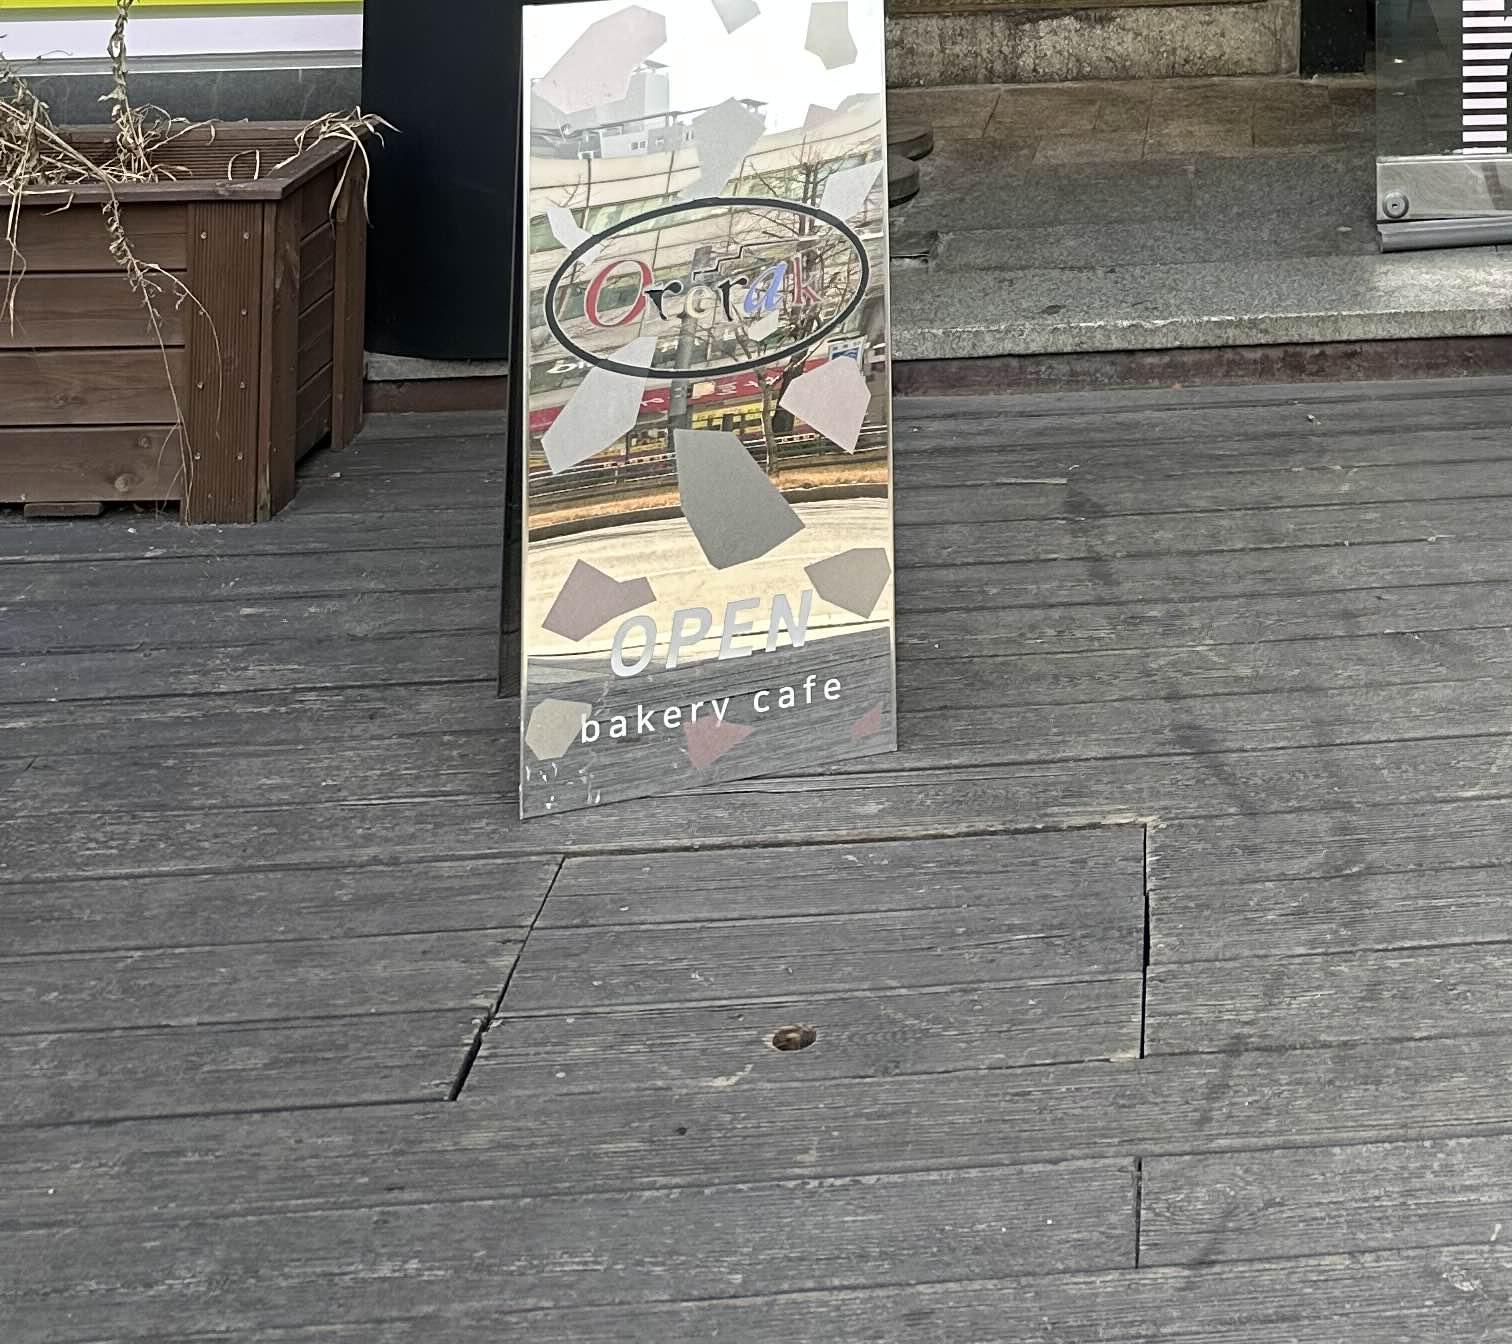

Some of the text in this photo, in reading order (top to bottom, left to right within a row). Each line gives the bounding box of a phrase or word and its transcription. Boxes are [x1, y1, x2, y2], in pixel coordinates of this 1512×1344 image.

[610, 589, 814, 677] OPEN
[580, 674, 842, 745] bakery cafe
